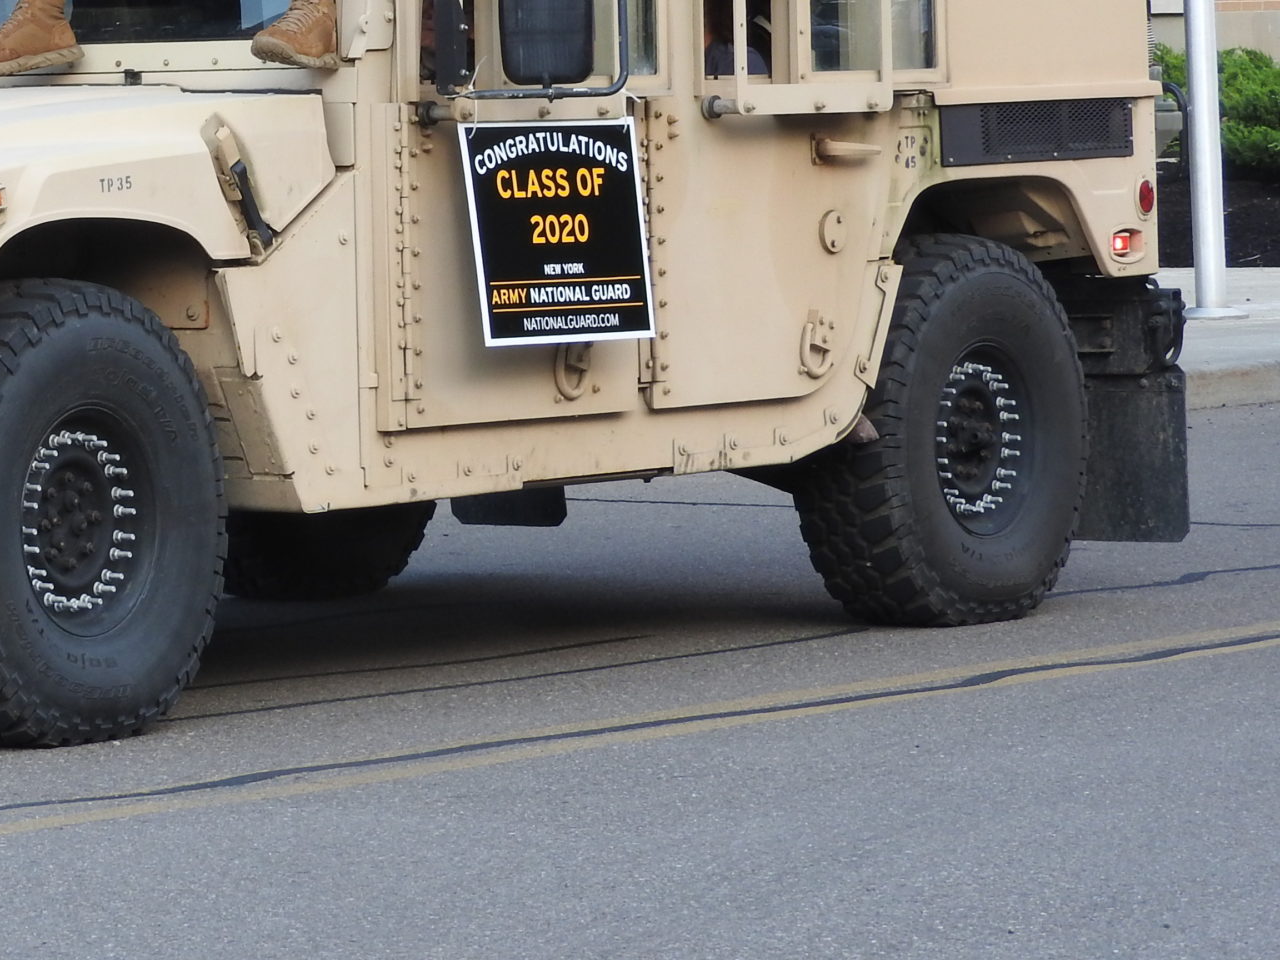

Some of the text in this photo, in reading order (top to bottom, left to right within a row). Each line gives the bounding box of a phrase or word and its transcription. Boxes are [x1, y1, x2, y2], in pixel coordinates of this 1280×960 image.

[905, 136, 915, 148] TP
[474, 132, 628, 175] CONGRATULATIONS
[496, 167, 604, 199] CLASS OF
[530, 213, 589, 244] 2020
[544, 262, 584, 275] NEW YORK
[492, 284, 630, 305] ARMY NATIONAL GUARD
[523, 313, 619, 331] NATIONALGUARD.COM
